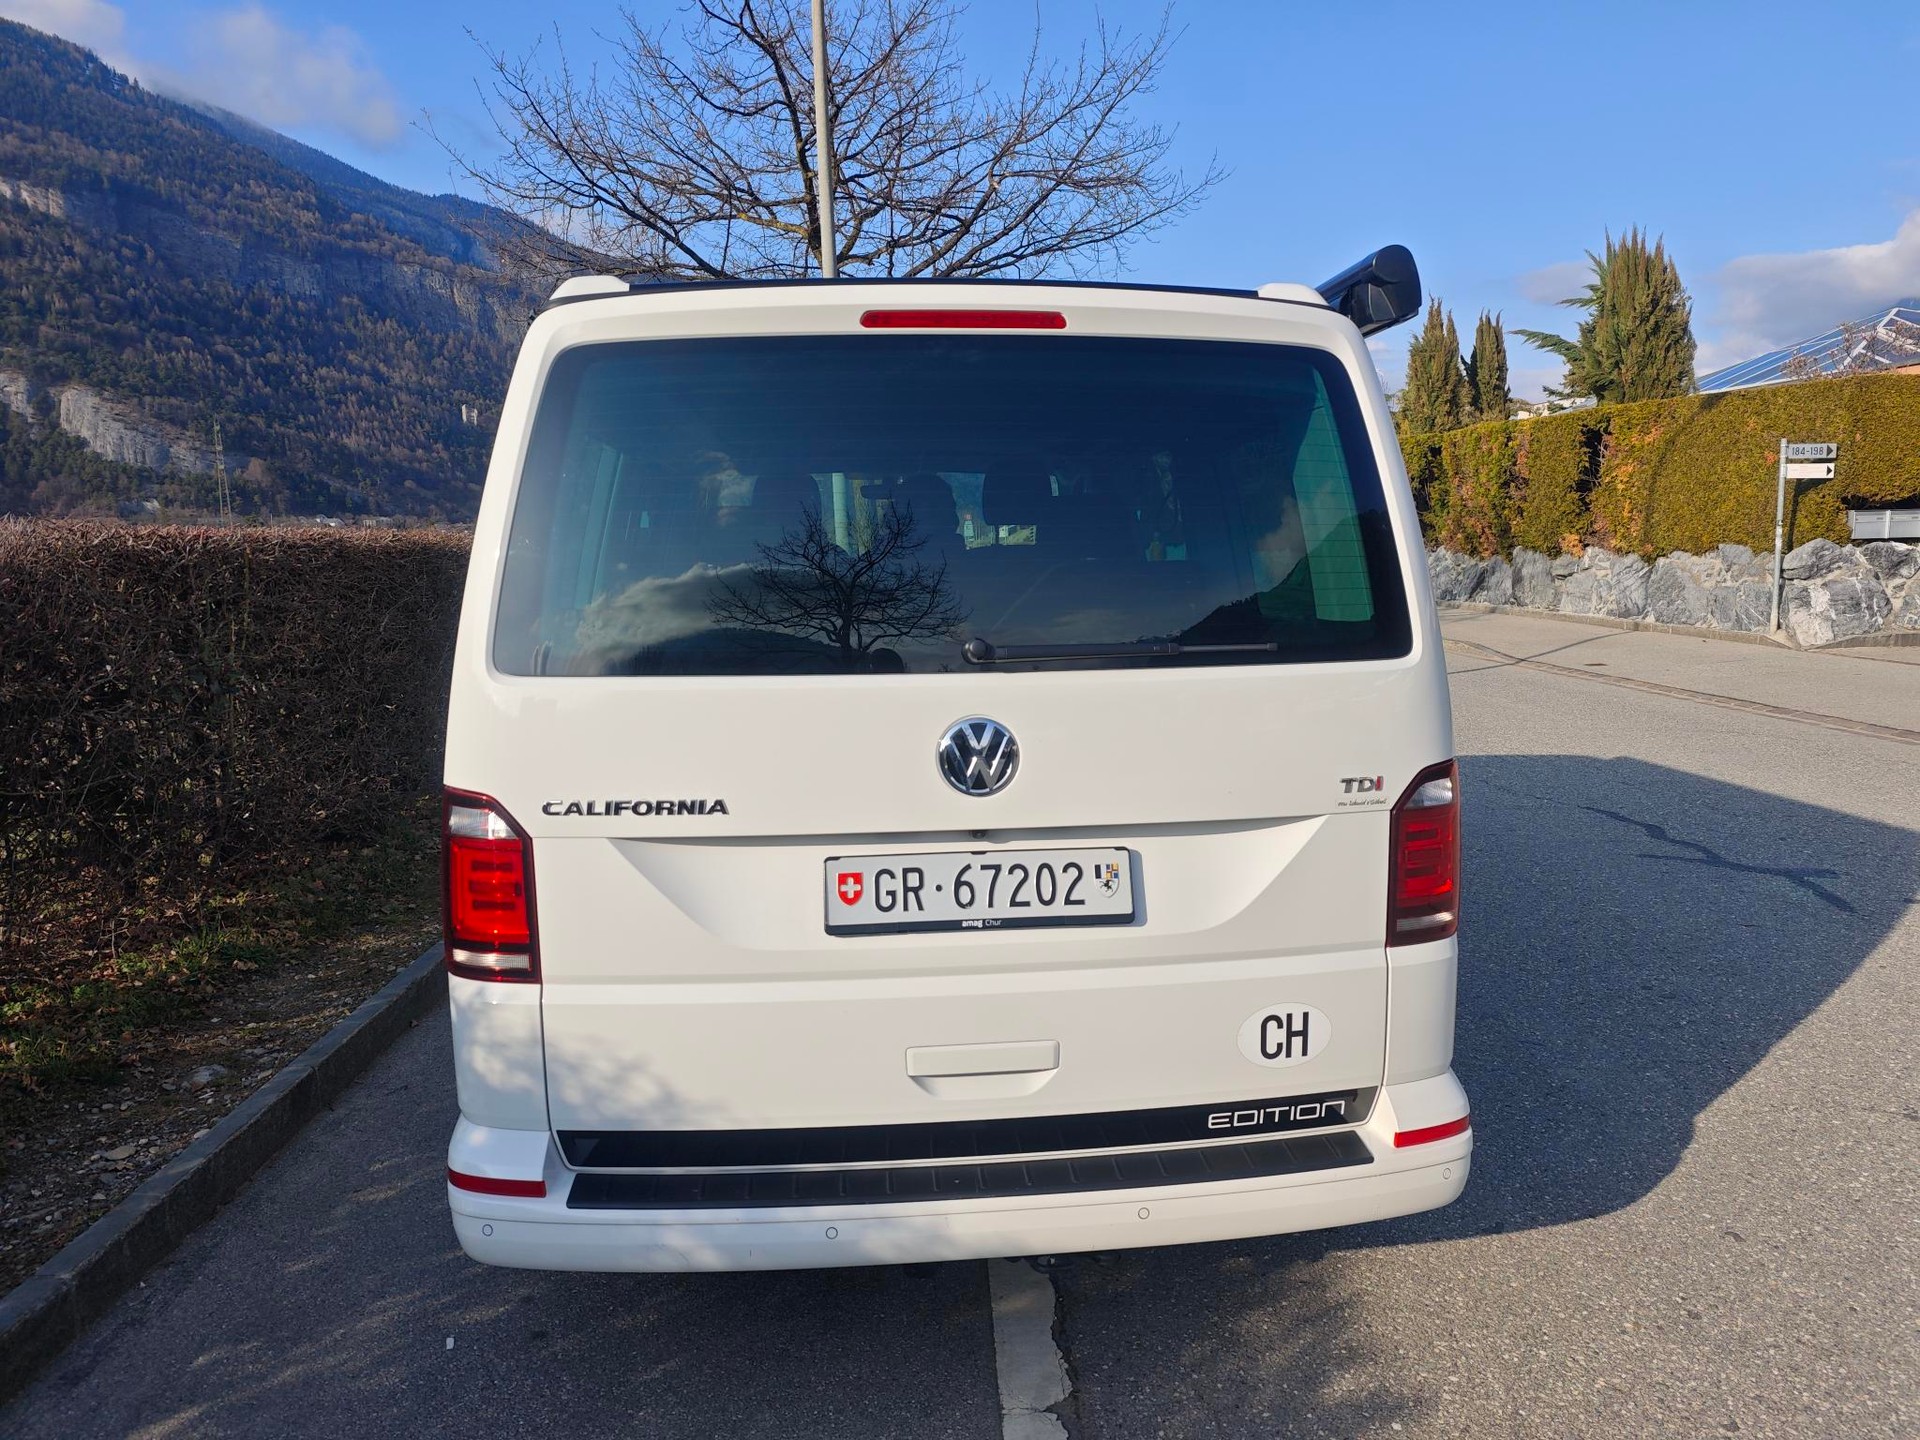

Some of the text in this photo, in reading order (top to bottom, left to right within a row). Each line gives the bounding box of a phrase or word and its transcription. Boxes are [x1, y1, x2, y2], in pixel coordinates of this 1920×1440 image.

[1791, 446, 1824, 456] 184-198
[939, 716, 1018, 795] VW
[542, 799, 729, 816] CALIFORNIA
[961, 919, 983, 928] amag
[1260, 1011, 1310, 1060] CH
[1207, 1100, 1346, 1129] EDITION
